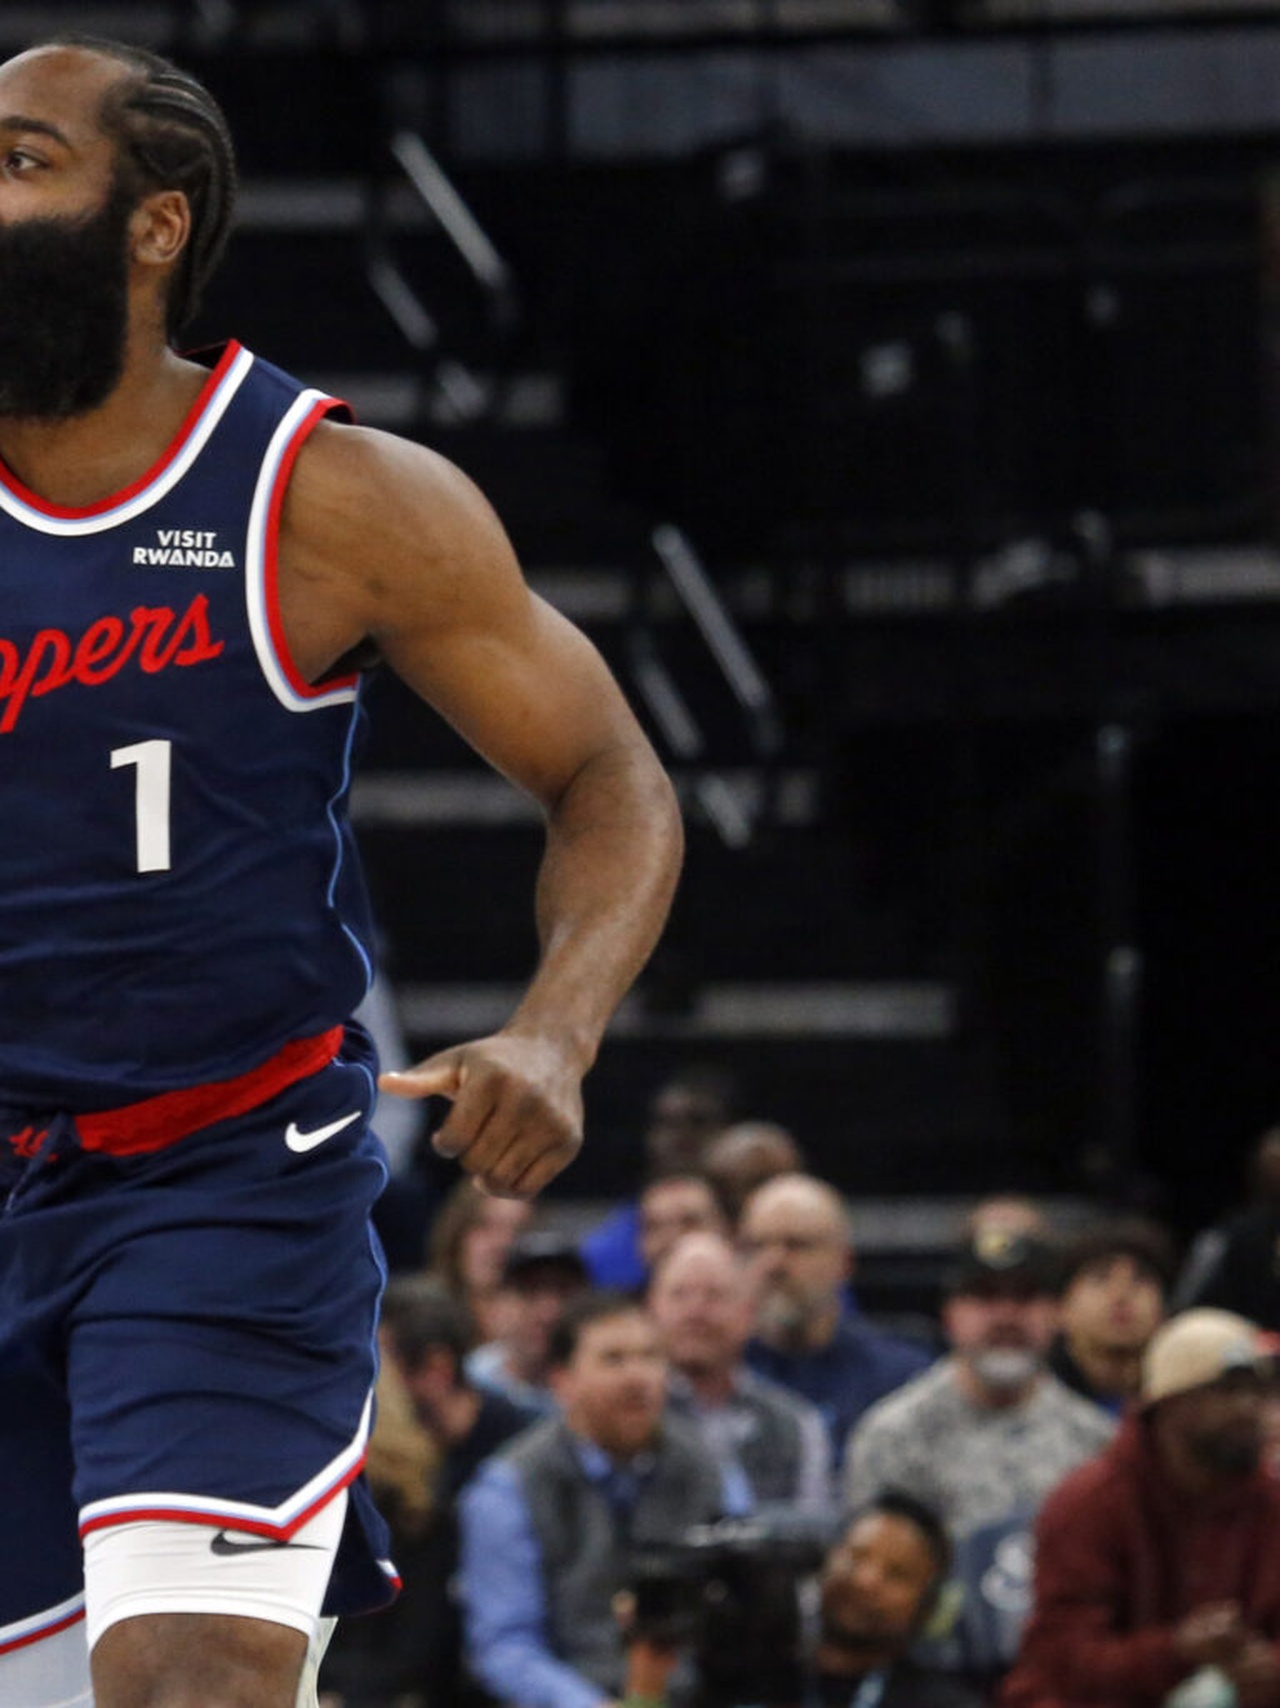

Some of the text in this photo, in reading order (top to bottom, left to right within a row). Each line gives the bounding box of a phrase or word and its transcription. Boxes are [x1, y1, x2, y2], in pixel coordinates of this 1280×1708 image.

[157, 529, 217, 549] VISIT
[132, 547, 236, 568] RWANDA
[110, 739, 172, 873] 1
